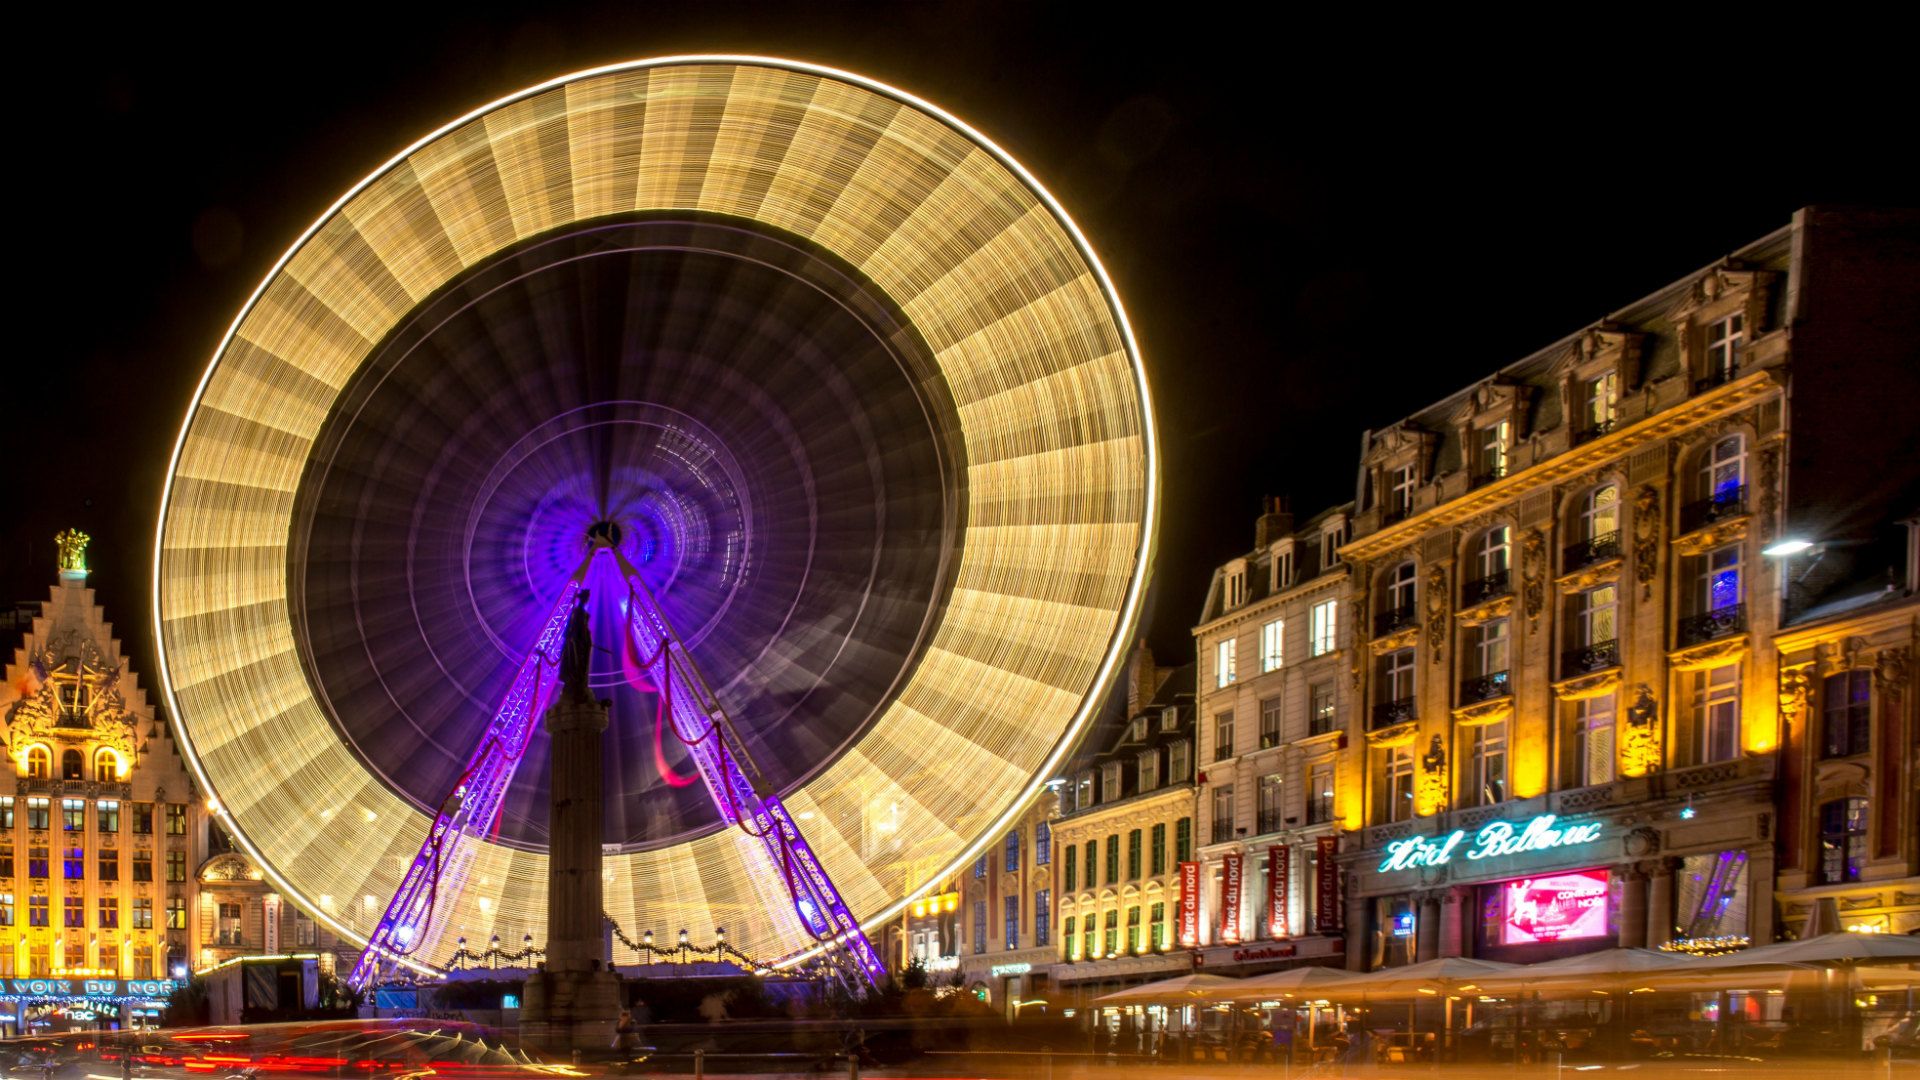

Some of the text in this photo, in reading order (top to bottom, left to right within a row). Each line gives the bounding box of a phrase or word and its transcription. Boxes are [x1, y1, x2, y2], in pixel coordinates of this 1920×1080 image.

[1378, 814, 1603, 872] Hôtel Bellevue
[1182, 865, 1195, 942] Furet du nord
[1224, 857, 1239, 938] Furet du nord
[1272, 849, 1286, 933] Furet du nord
[1322, 840, 1335, 928] Furet du nord
[13, 981, 72, 995] VOIX
[86, 981, 116, 995] DU
[83, 1000, 118, 1018] PLACE
